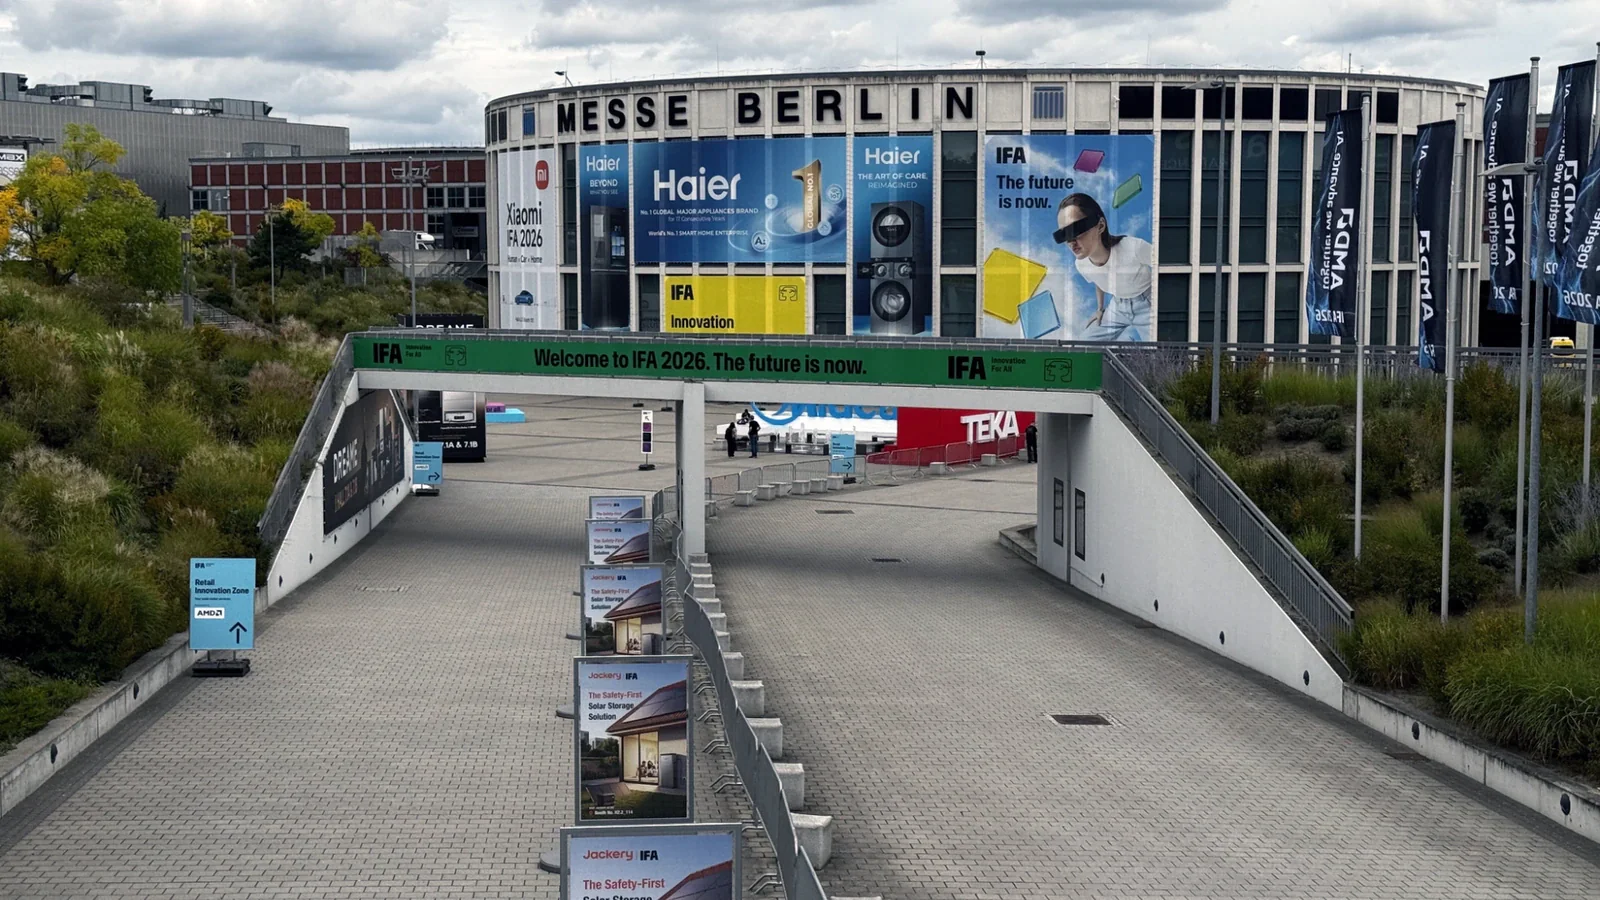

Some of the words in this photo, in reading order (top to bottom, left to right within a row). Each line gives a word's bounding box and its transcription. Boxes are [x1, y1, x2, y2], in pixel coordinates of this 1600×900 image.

[557, 95, 688, 133] MESSE
[738, 86, 974, 124] BERLIN
[586, 154, 620, 172] Haier
[865, 147, 920, 165] Haier
[996, 147, 1026, 164] IFA
[590, 179, 618, 187] BEYOND
[654, 166, 742, 201] Haier
[996, 175, 1024, 190] The
[1028, 174, 1074, 190] future
[999, 194, 1011, 208] is
[1015, 197, 1052, 208] now.
[506, 201, 542, 226] Xiaomi
[506, 229, 519, 247] IFA
[520, 229, 543, 248] 2026
[670, 284, 694, 300] IFA
[670, 314, 734, 330] Innovation
[373, 343, 402, 364] IFA
[534, 349, 608, 368] Welcome
[612, 351, 628, 368] to
[632, 351, 658, 369] IFA
[661, 351, 710, 370] 2026.
[713, 352, 745, 371] The
[748, 354, 800, 372] future
[804, 355, 820, 373] is
[824, 357, 867, 374] now.
[948, 356, 986, 380] IFA
[960, 410, 1020, 444] TEKA
[588, 672, 621, 680] Jackery
[602, 691, 642, 699] Safety-First
[583, 850, 633, 861] Jackery
[640, 850, 658, 860] IFA
[583, 880, 601, 890] The
[605, 878, 665, 890] Safety-First
